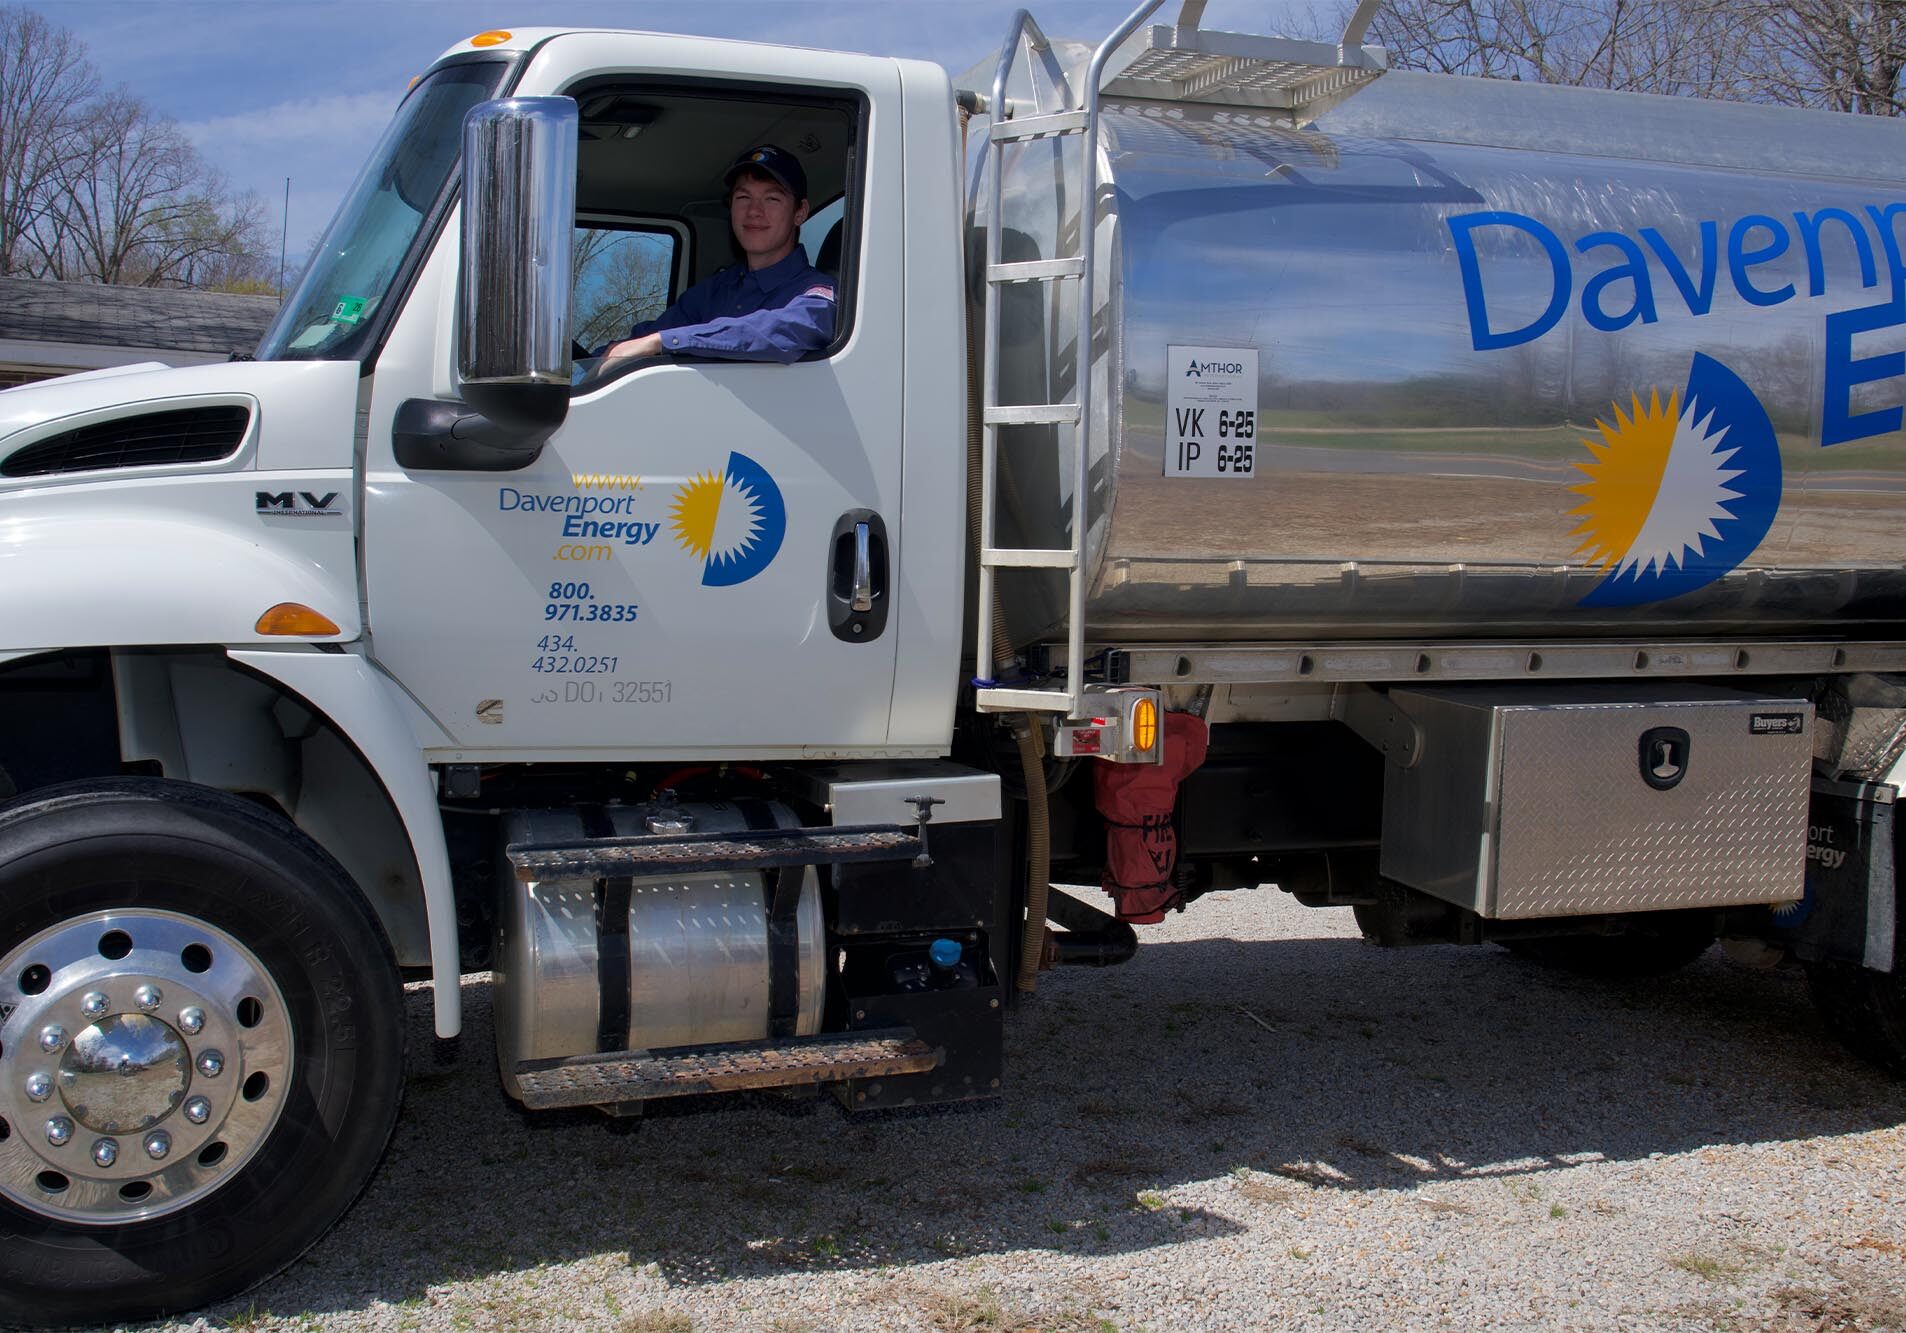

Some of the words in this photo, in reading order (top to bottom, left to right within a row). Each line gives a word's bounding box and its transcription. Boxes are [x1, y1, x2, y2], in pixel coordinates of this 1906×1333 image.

[1185, 360, 1243, 377] AMTHOR
[1176, 408, 1205, 437] VK
[1219, 410, 1254, 438] 6-25
[1178, 442, 1200, 471] IP
[1217, 445, 1253, 473] 6-25
[499, 487, 635, 517] Davenport
[562, 515, 660, 545] Energy
[552, 543, 612, 561] .com
[549, 582, 595, 600] 800.
[544, 603, 638, 622] 971.3835
[537, 635, 578, 652] 434.
[531, 656, 619, 673] 432.0251
[1754, 716, 1788, 730] Buyers
